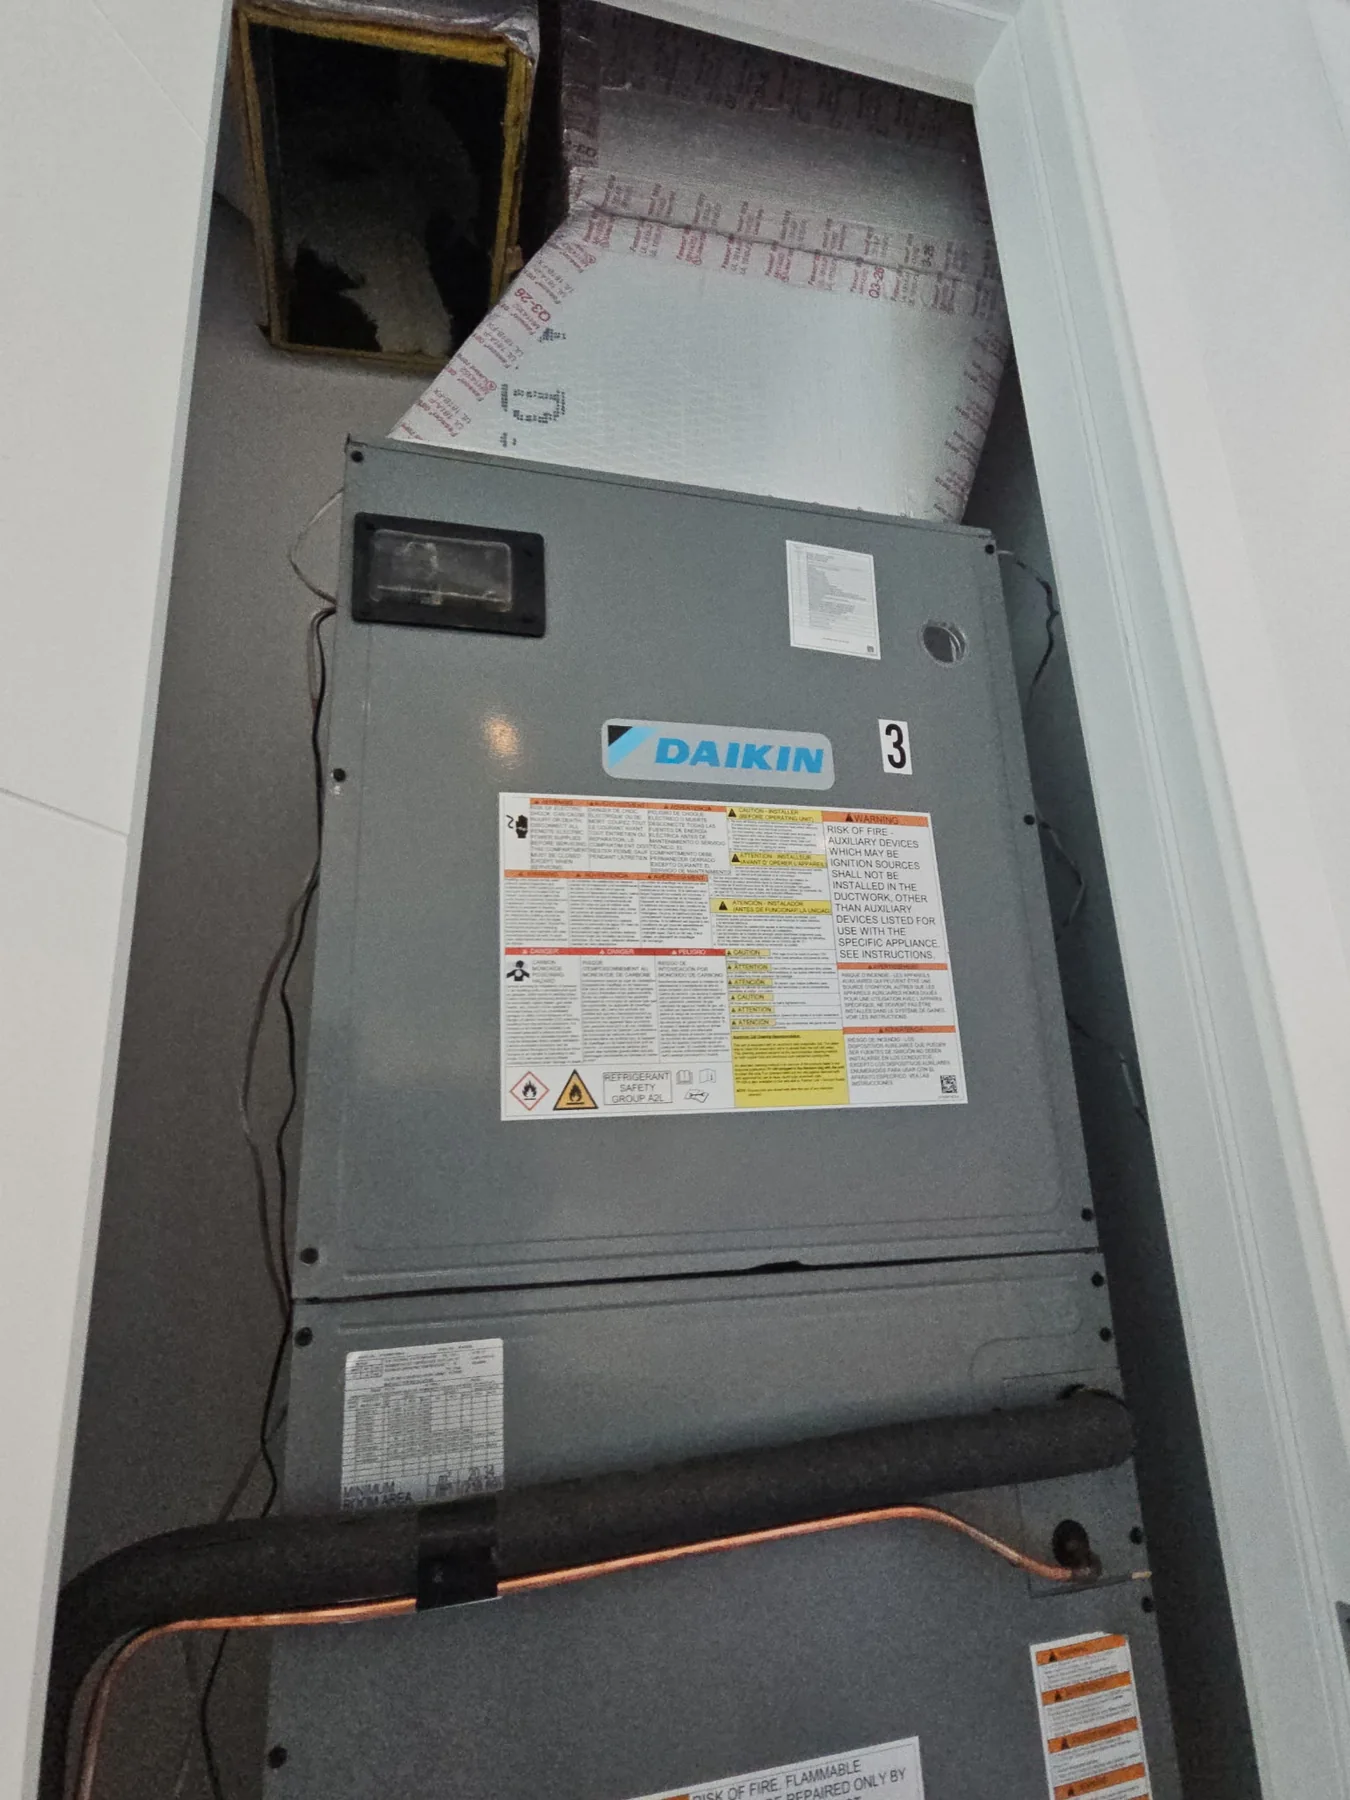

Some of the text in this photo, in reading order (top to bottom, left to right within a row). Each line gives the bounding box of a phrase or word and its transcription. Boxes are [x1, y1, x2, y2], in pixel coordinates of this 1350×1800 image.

[867, 265, 884, 298] Q3-26
[513, 285, 552, 324] Q3-26
[884, 723, 907, 769] 3
[655, 737, 824, 774] DAIKIN
[855, 814, 899, 824] WARNING
[827, 825, 888, 836] RISK OF FIRE
[828, 837, 919, 848] AUXILIARY DEVICES
[829, 848, 899, 858] WHICH MAY BE
[831, 859, 920, 870] IGNITION SOURCES
[832, 870, 899, 880] SHALL NOT BE
[832, 881, 917, 891] INSTALLED IN THE
[834, 892, 928, 903] DUCTWORK, OTHER
[836, 904, 912, 913] THAN AUXILIARY
[836, 915, 936, 925] DEVICES LISTED FOR
[837, 927, 906, 936] USE WITH THE
[839, 938, 940, 948] SPECIFIC APPLIANCE.
[840, 950, 935, 960] SEE INSTRUCTIONS.
[604, 1072, 669, 1081] REFRIGERANT
[620, 1083, 656, 1092] SAFETY
[612, 1094, 646, 1103] GROUP
[727, 1785, 745, 1800] OF
[785, 1759, 861, 1787] FLAMMABLE
[786, 1767, 906, 1800] REPAIRED ONLY BY
